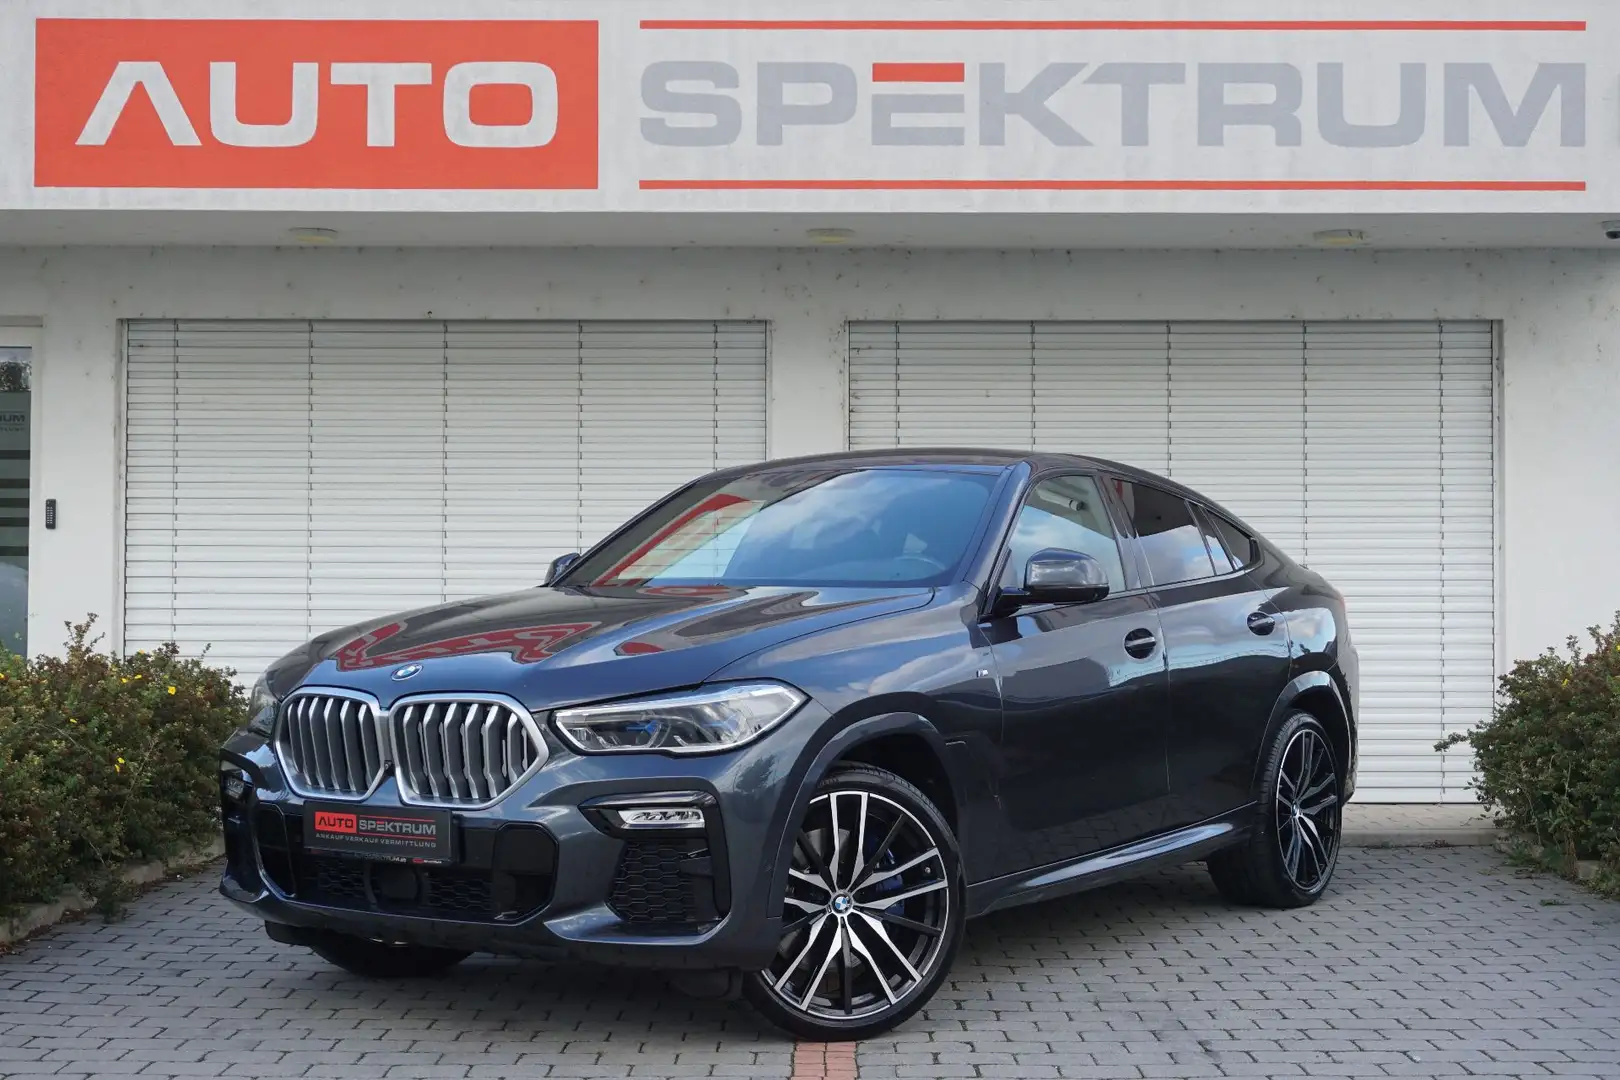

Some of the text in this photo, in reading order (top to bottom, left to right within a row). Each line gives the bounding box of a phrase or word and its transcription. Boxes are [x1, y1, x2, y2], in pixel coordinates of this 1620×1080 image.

[75, 60, 1587, 149] AUTO SPEKTRUM
[318, 816, 436, 834] AUTO SPEKTRUM
[380, 838, 437, 848] VERMITTLUNG
